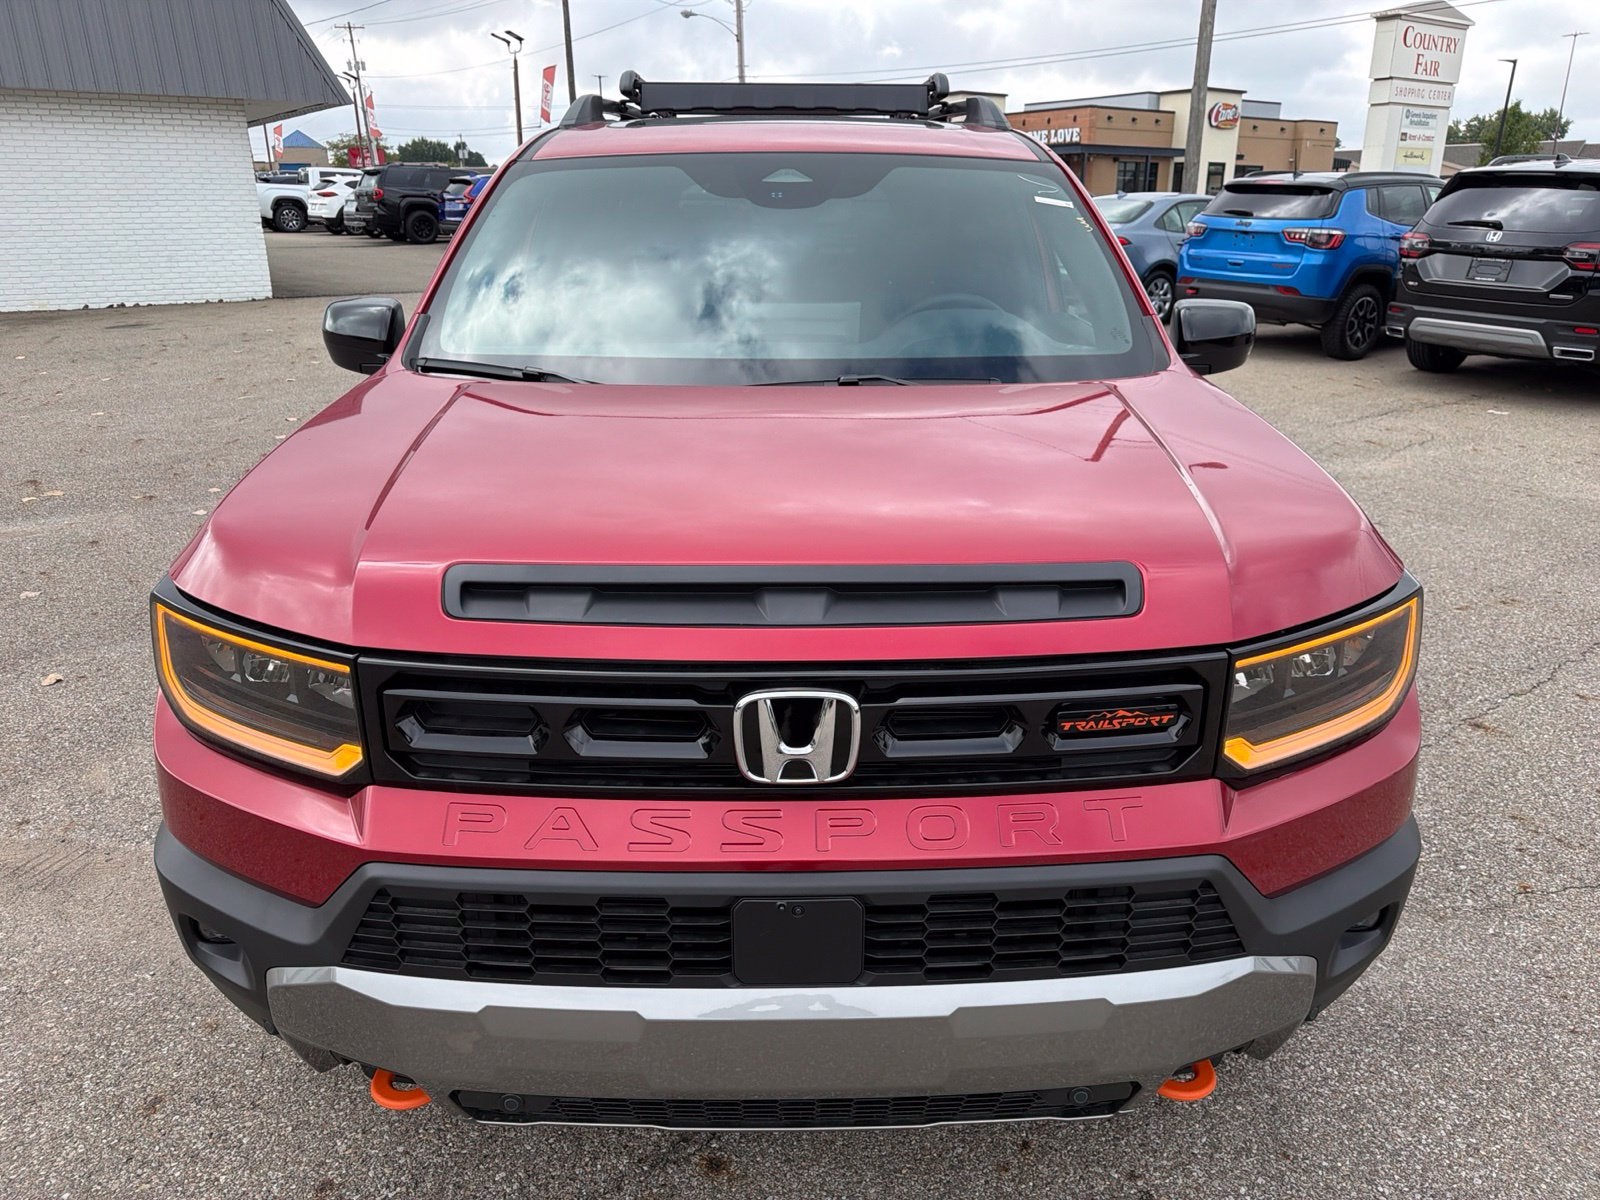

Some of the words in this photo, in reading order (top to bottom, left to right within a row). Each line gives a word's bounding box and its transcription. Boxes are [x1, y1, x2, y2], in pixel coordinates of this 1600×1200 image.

[1402, 25, 1460, 54] COUNTRY
[1414, 53, 1440, 77] FAIR
[1394, 86, 1425, 99] SHOPPING
[1428, 89, 1452, 101] CENTER
[1050, 127, 1080, 144] LOVE
[1060, 714, 1174, 732] TRAILSPORT
[441, 796, 1143, 852] PASSPORT
